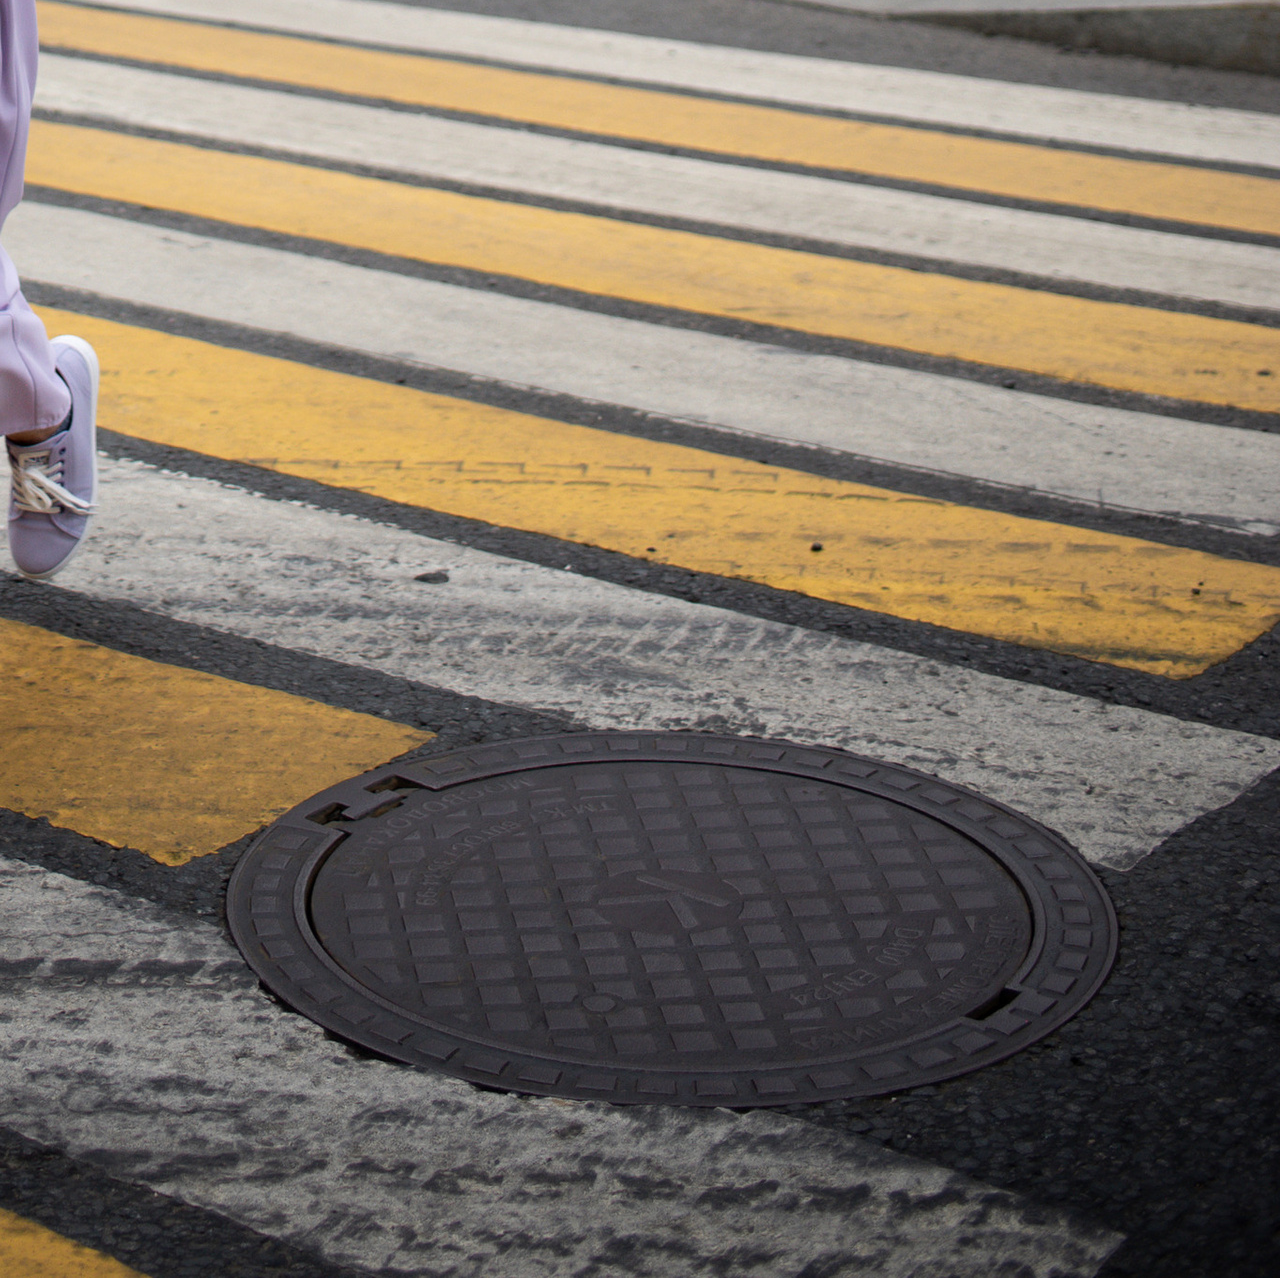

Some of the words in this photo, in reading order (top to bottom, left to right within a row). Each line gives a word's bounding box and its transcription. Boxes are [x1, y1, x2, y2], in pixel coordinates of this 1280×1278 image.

[334, 775, 536, 879] МОСВОДОКАНАЛ
[793, 912, 1016, 1052] ЭЛЕКТРОМЕХАНИКА
[874, 926, 924, 968] D400
[791, 968, 881, 1007] EN124
